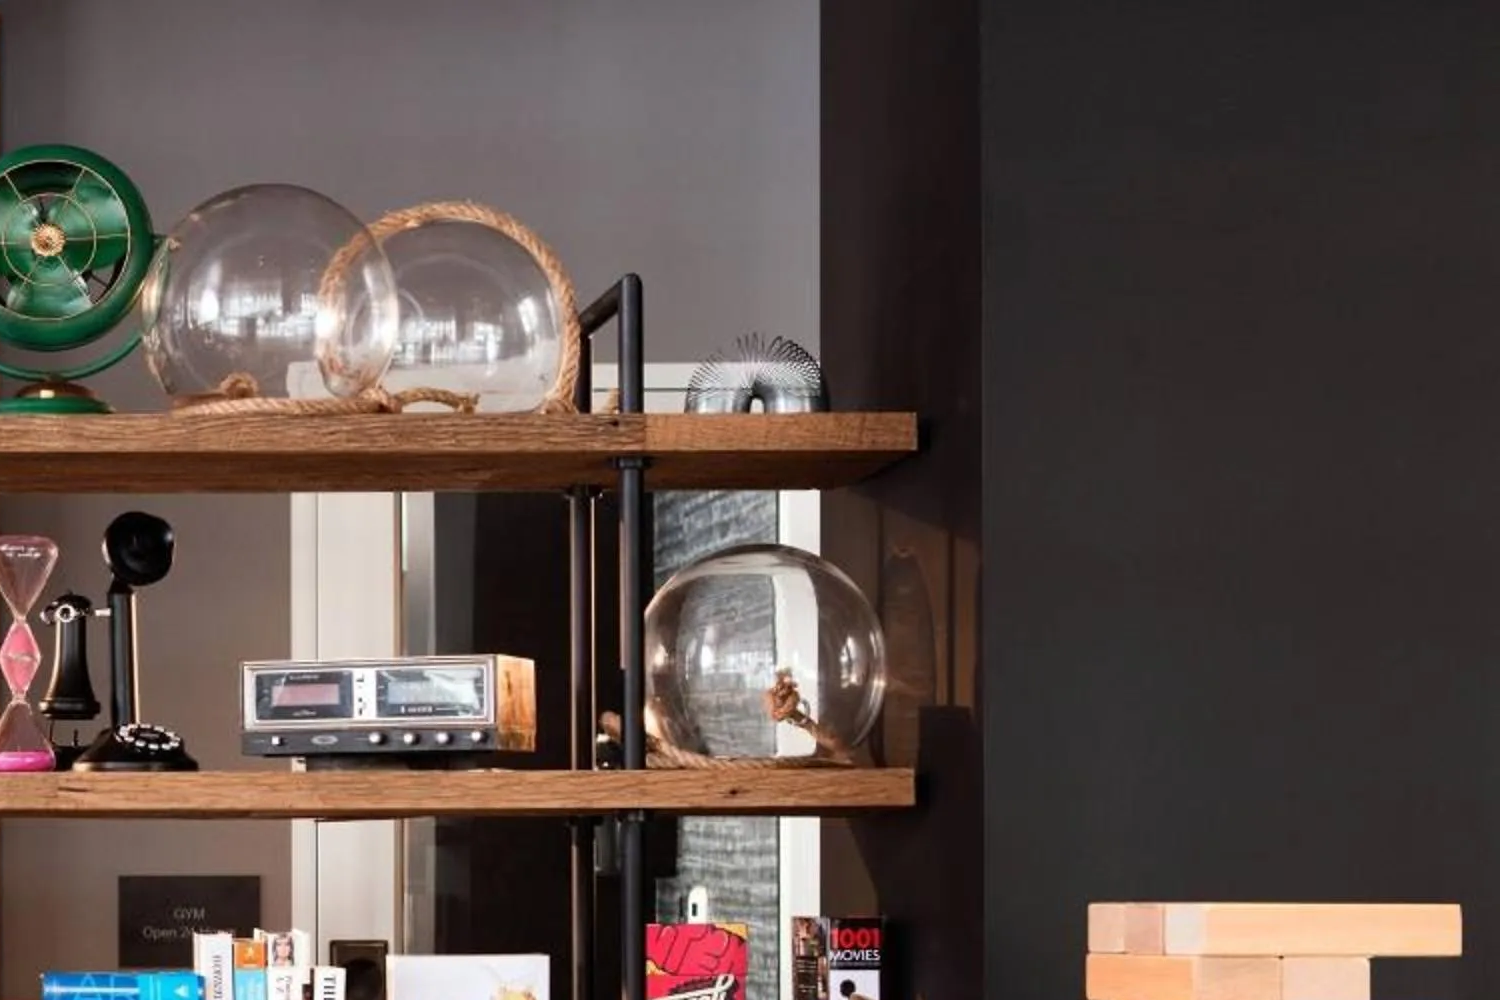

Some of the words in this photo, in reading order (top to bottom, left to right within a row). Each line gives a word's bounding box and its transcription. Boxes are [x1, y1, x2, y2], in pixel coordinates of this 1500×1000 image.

[173, 908, 205, 920] GYM
[142, 926, 177, 941] Open
[831, 927, 880, 948] 1001
[830, 950, 881, 962] MOVIES
